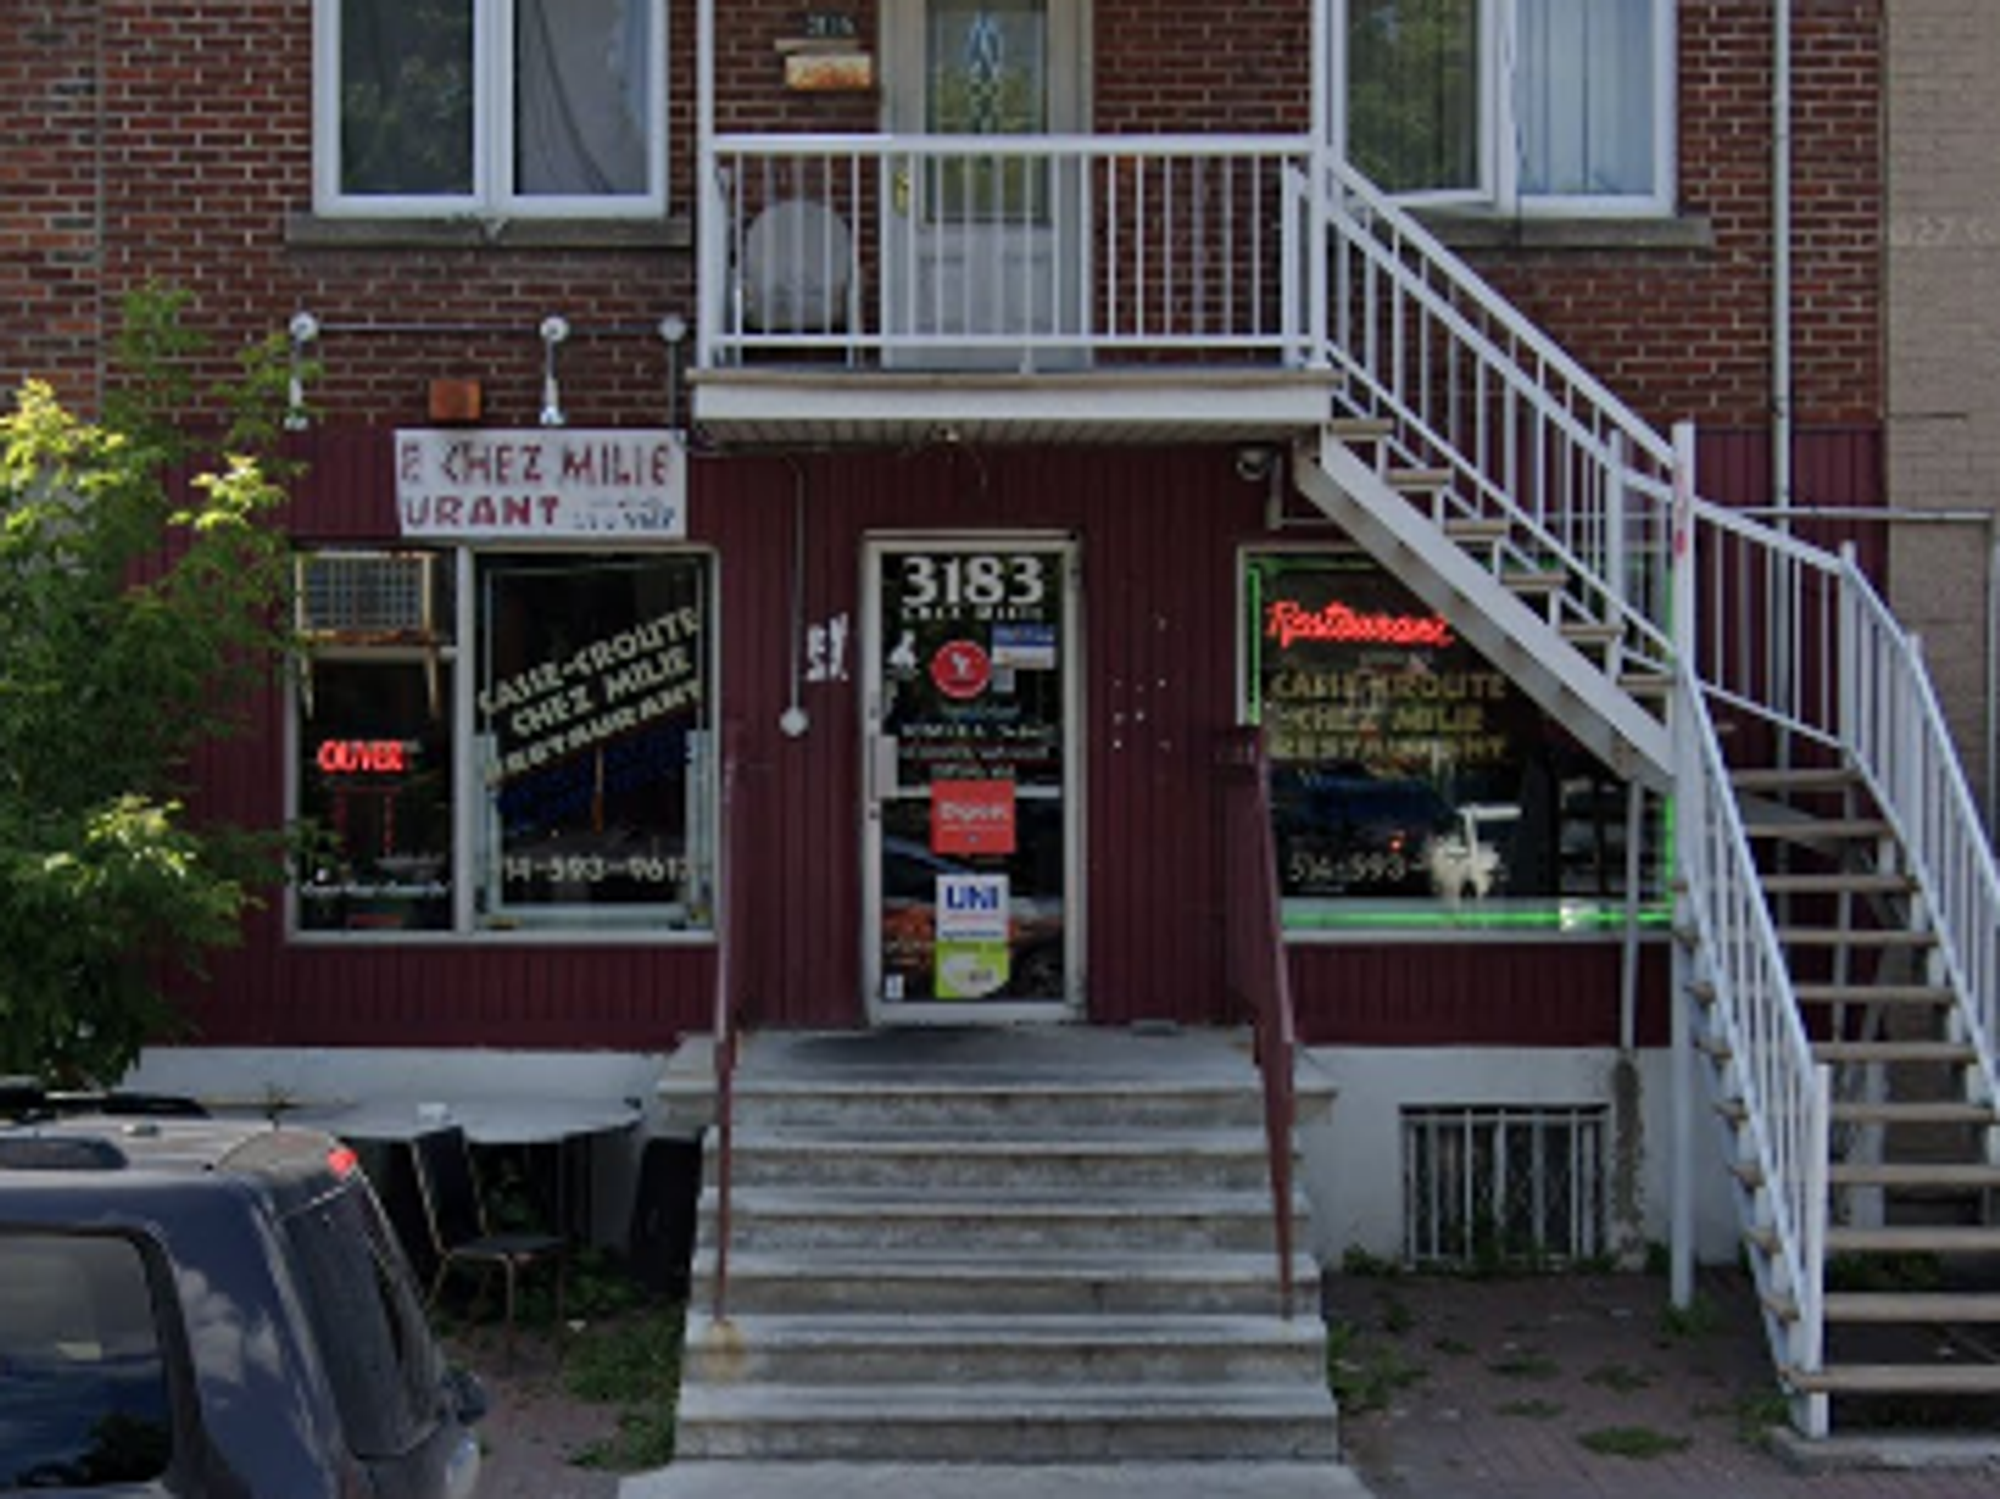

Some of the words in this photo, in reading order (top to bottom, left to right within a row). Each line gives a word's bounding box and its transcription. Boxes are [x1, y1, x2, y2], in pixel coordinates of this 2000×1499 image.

[441, 441, 543, 486] CHEZ
[405, 495, 560, 528] URANT
[902, 556, 1044, 605] 3183
[511, 684, 594, 737] CHEZ
